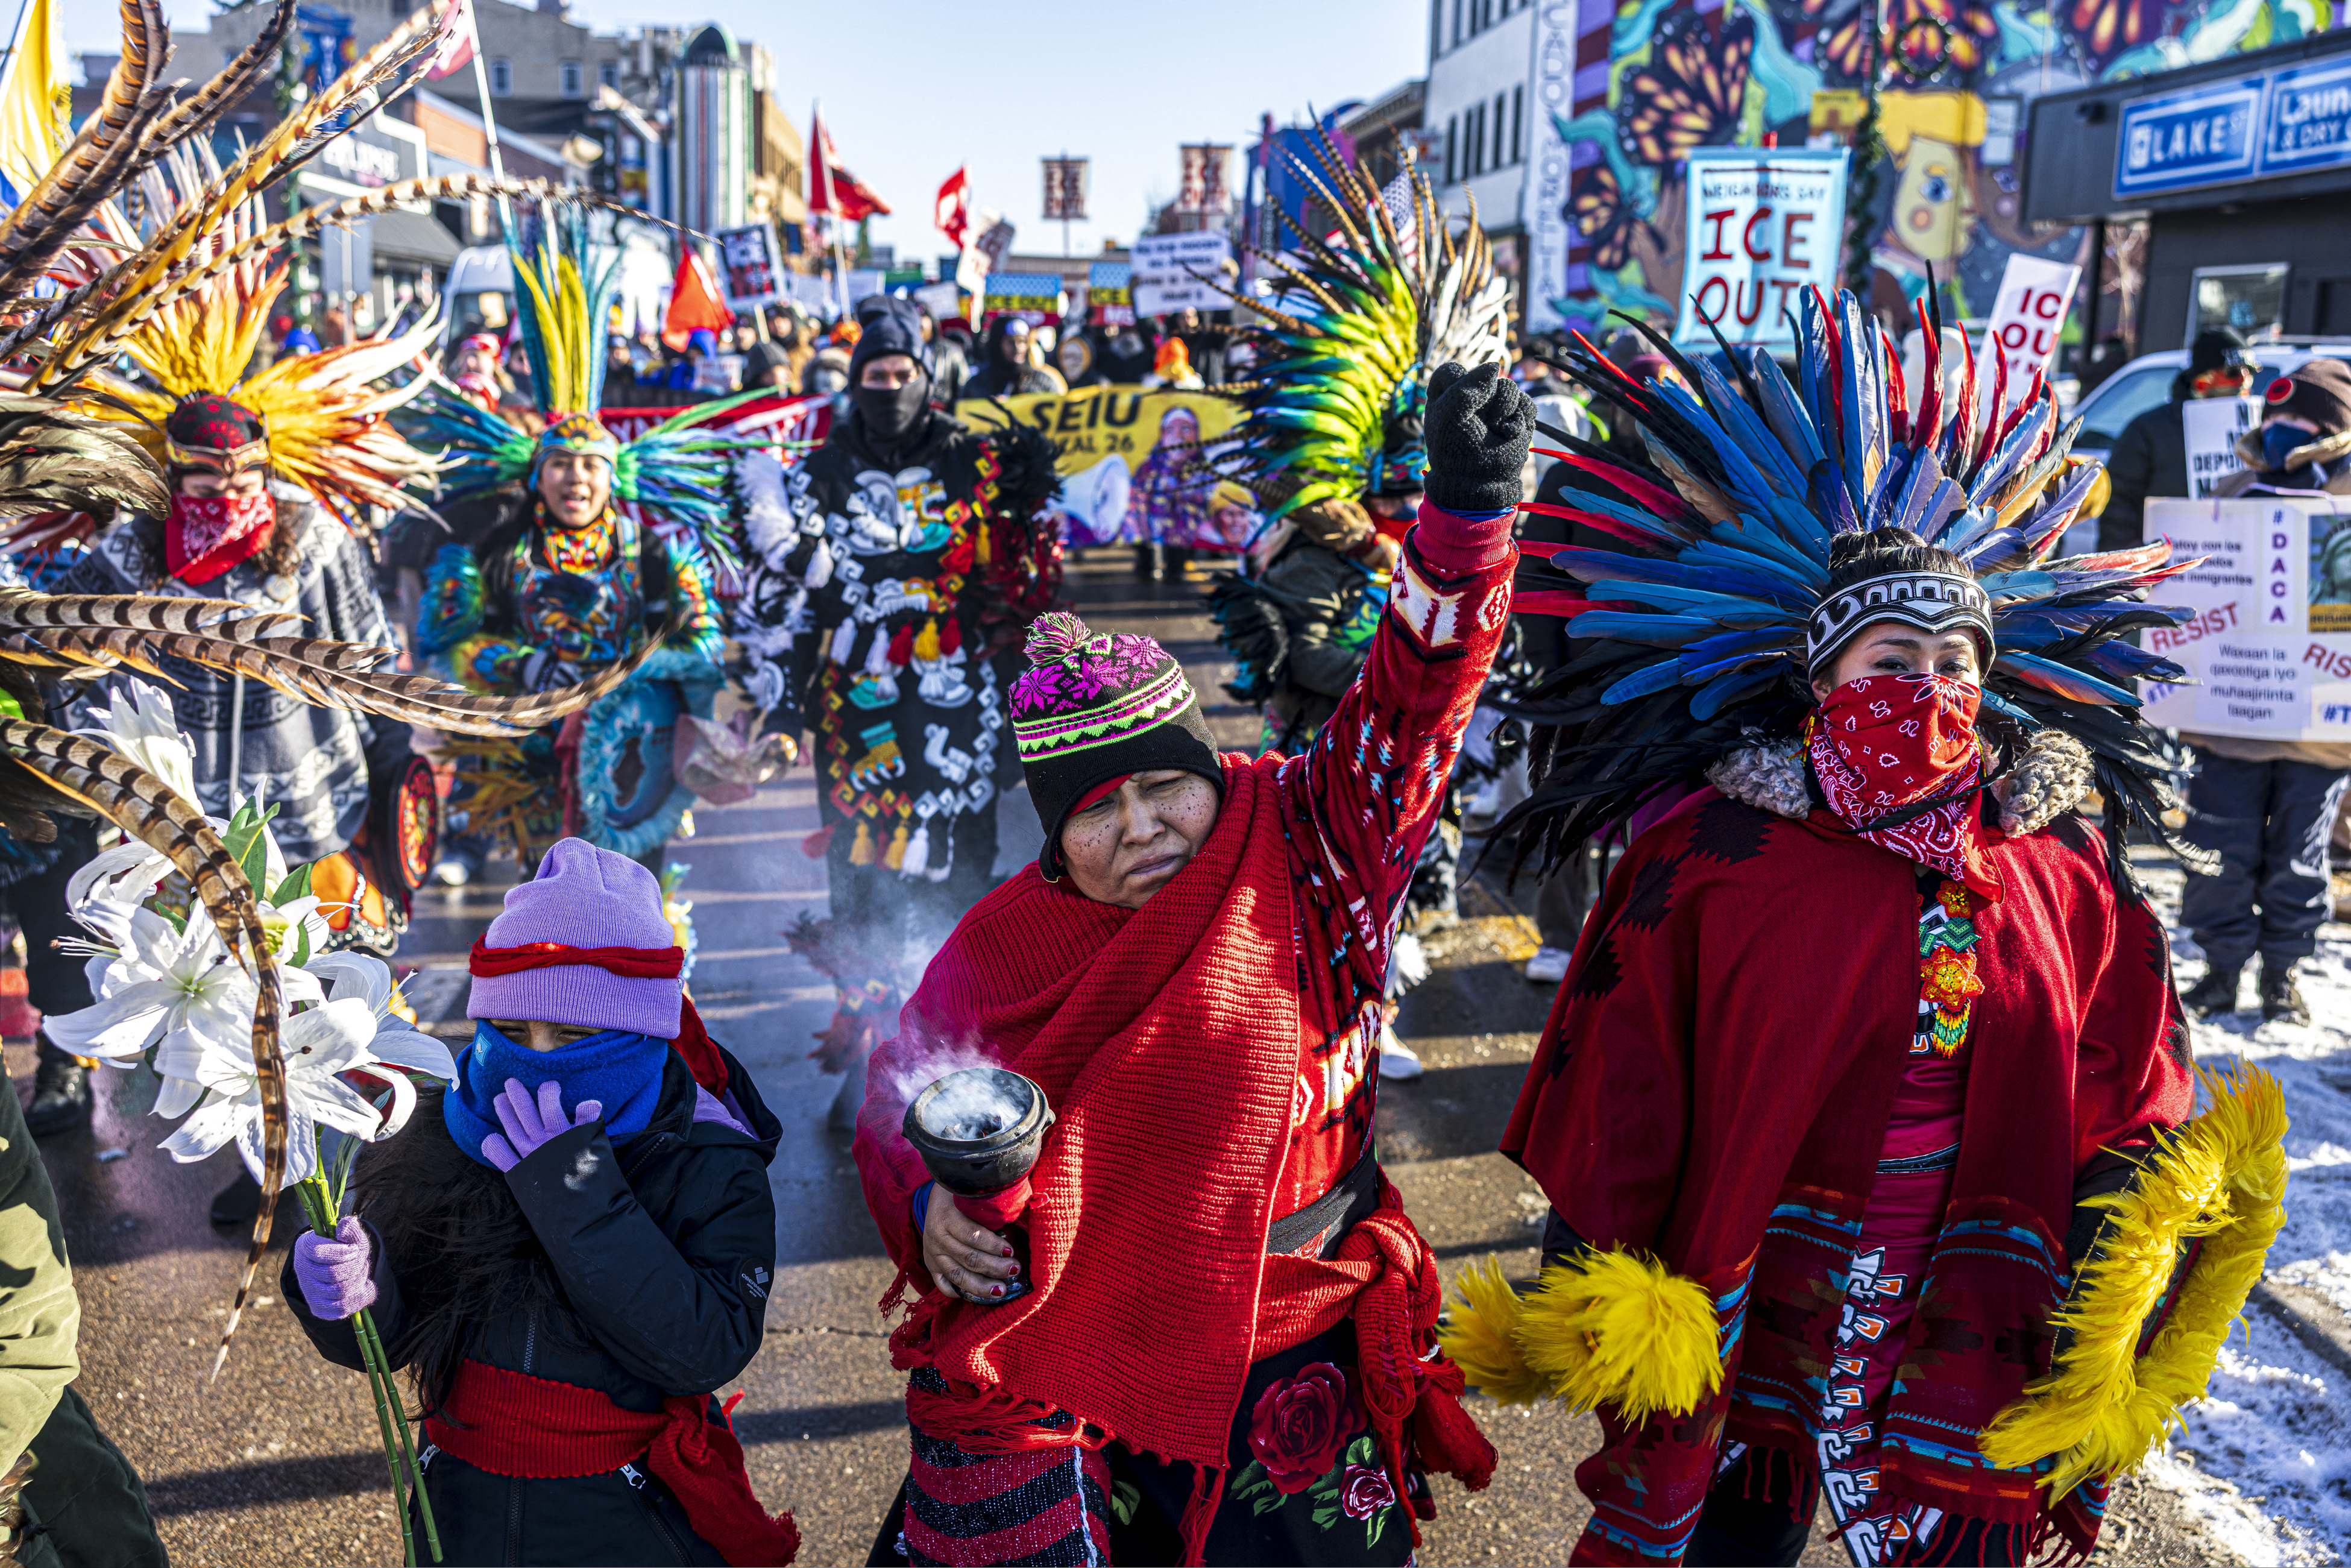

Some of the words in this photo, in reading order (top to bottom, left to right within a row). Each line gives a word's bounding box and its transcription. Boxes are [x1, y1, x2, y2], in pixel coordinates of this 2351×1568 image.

[1797, 186, 1826, 200] SAY
[1702, 207, 1813, 269] ICE
[1695, 276, 1800, 327] OUT
[1032, 392, 1143, 432] SEIU
[1105, 433, 1135, 452] 26
[2171, 540, 2198, 552] stoy
[2201, 540, 2221, 550] con
[2188, 573, 2252, 587] inmigrantes
[2150, 602, 2239, 652] RESIST
[2274, 665, 2297, 682] iyo
